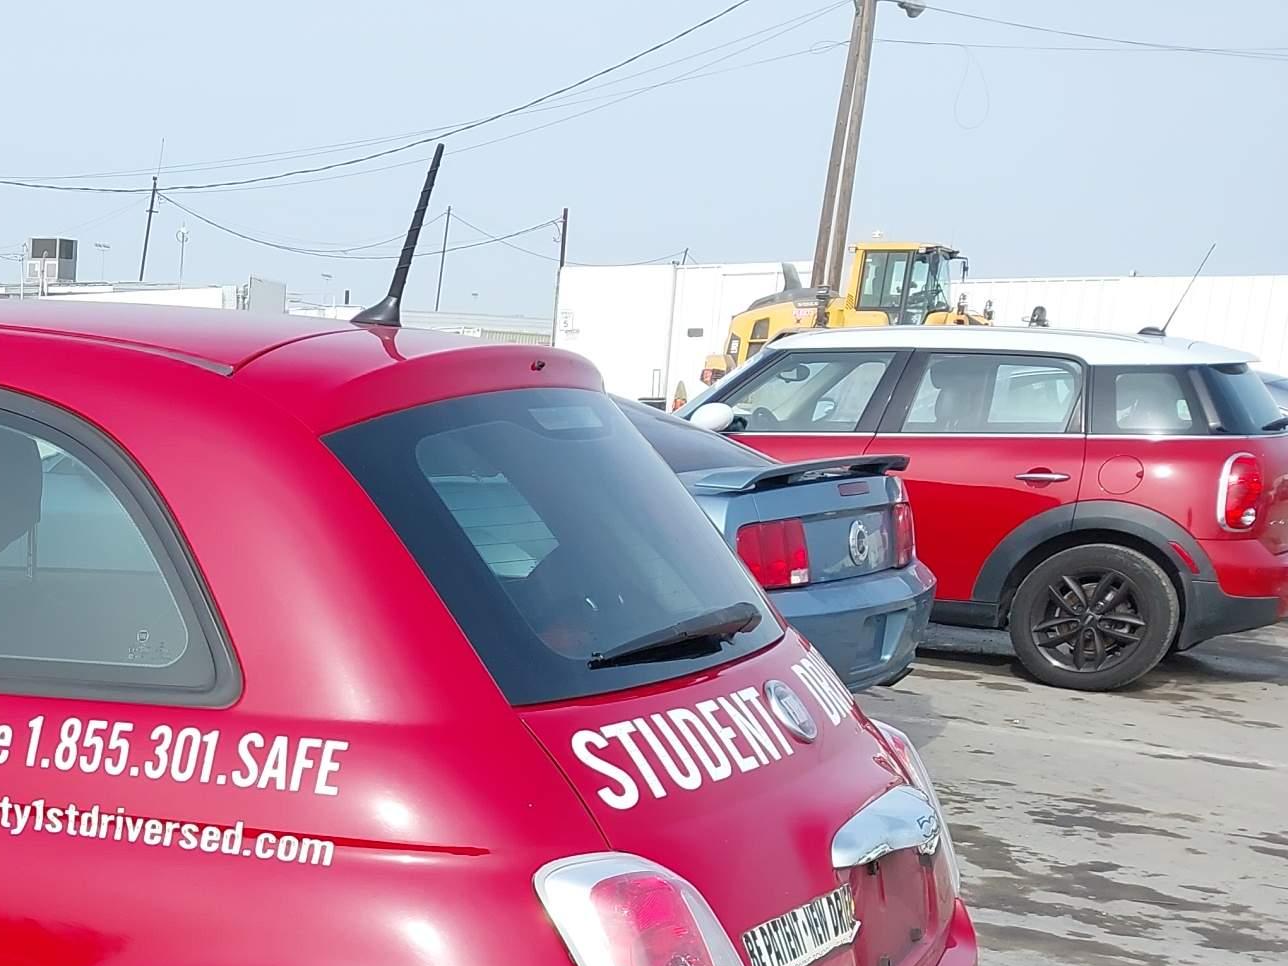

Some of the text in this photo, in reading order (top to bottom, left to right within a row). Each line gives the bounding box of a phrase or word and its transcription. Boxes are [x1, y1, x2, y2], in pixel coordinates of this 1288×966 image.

[24, 715, 349, 797] 1.855.301.SAFE
[571, 643, 855, 810] STUDENT DRIV
[802, 897, 832, 949] NEW
